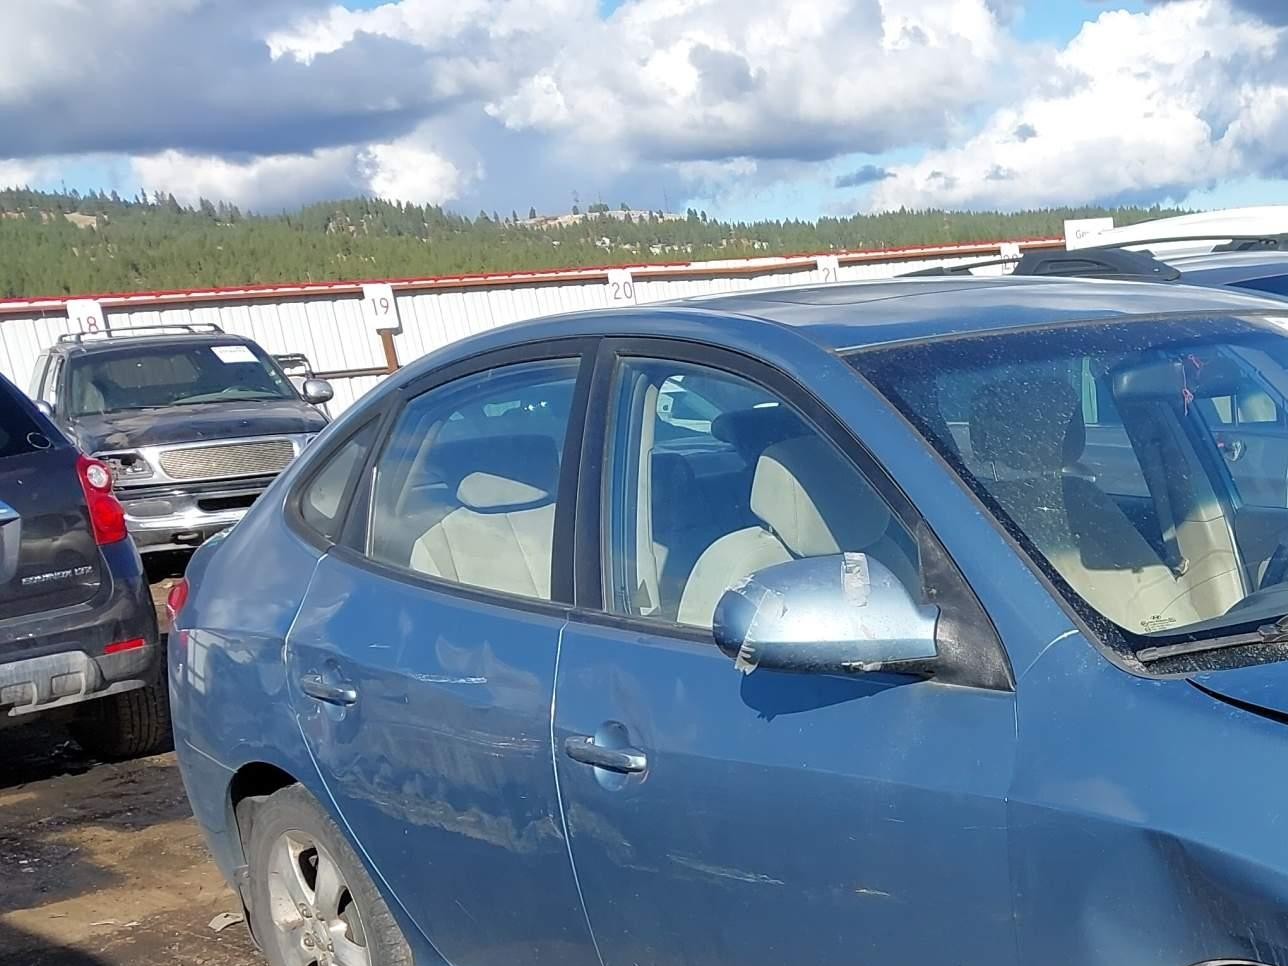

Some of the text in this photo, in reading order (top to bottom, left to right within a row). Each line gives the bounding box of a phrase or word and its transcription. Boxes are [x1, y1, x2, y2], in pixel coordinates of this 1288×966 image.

[611, 281, 633, 300] 20
[371, 297, 389, 316] 19
[77, 316, 100, 335] 18
